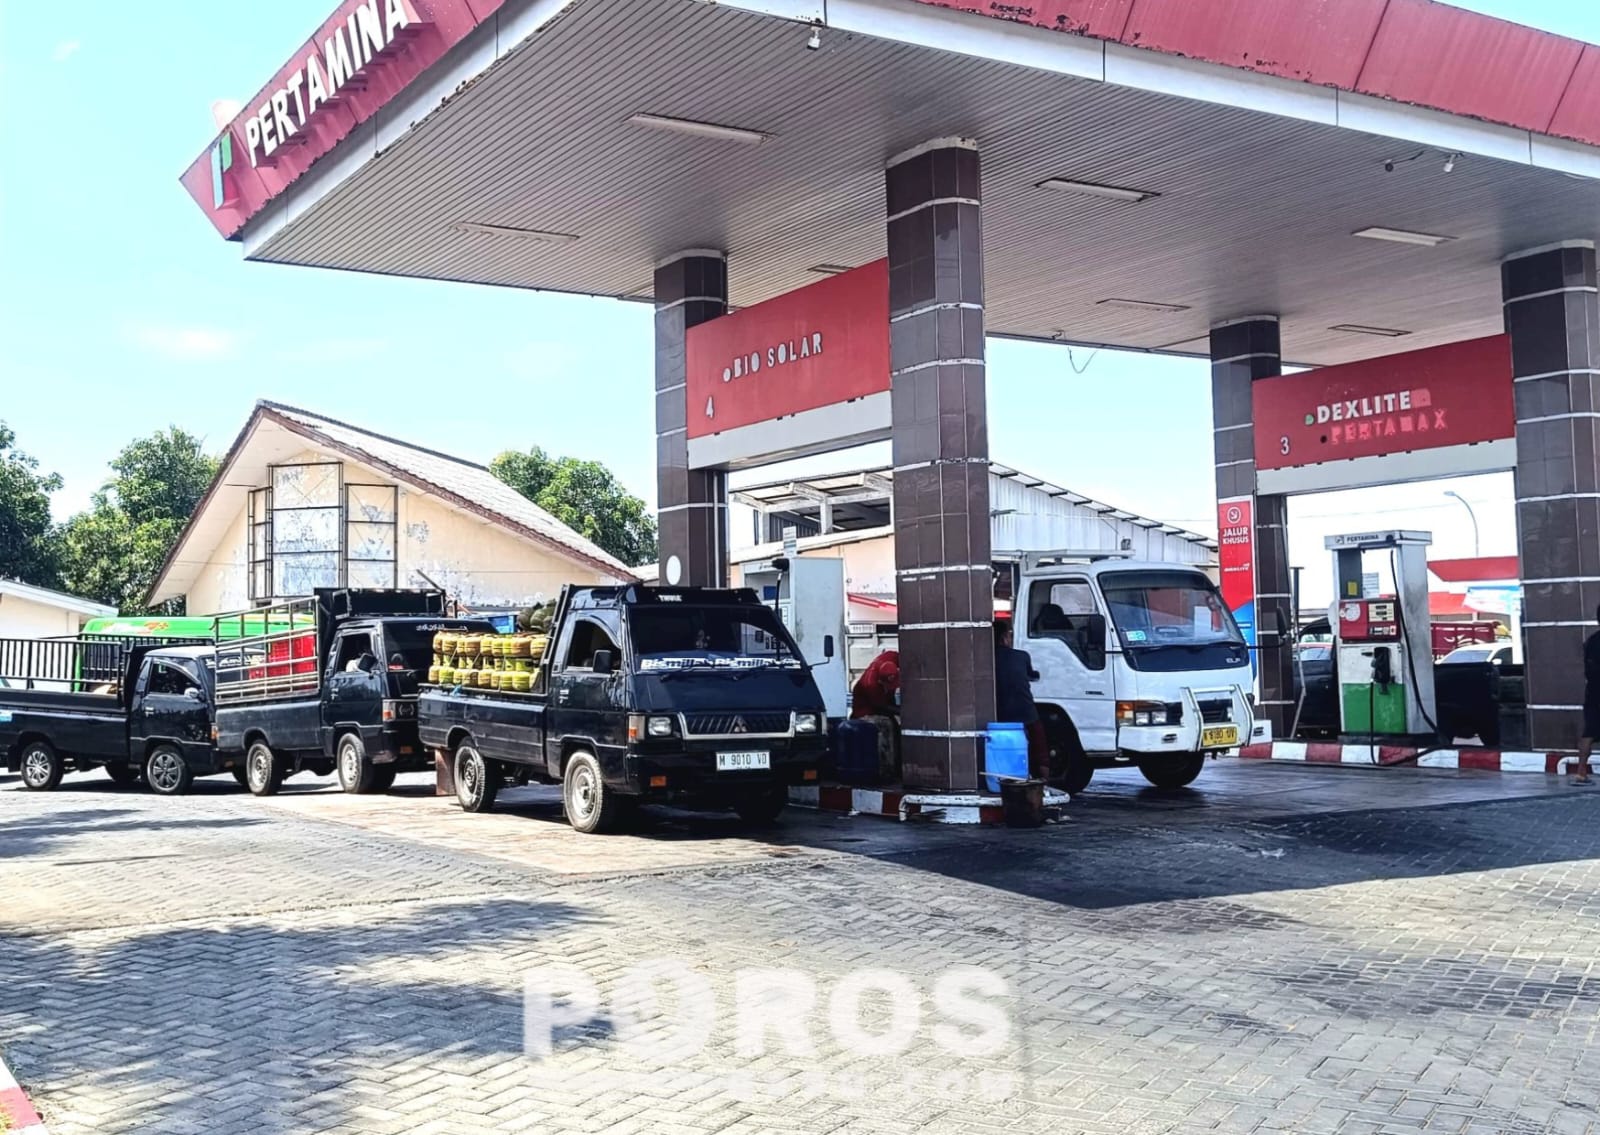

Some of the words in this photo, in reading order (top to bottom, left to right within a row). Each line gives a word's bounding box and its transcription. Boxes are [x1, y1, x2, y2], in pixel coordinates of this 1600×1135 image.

[246, 0, 409, 167] PERTAMINA
[734, 352, 760, 378] BIO
[767, 333, 822, 368] SOLAR
[1316, 390, 1411, 425] DEXLITE
[1331, 409, 1447, 445] PERTAMAX
[1280, 436, 1290, 456] 3
[1223, 527, 1248, 537] JALUR
[1223, 536, 1249, 545] KHUSUS
[719, 754, 726, 766] M
[731, 754, 752, 766] 9010
